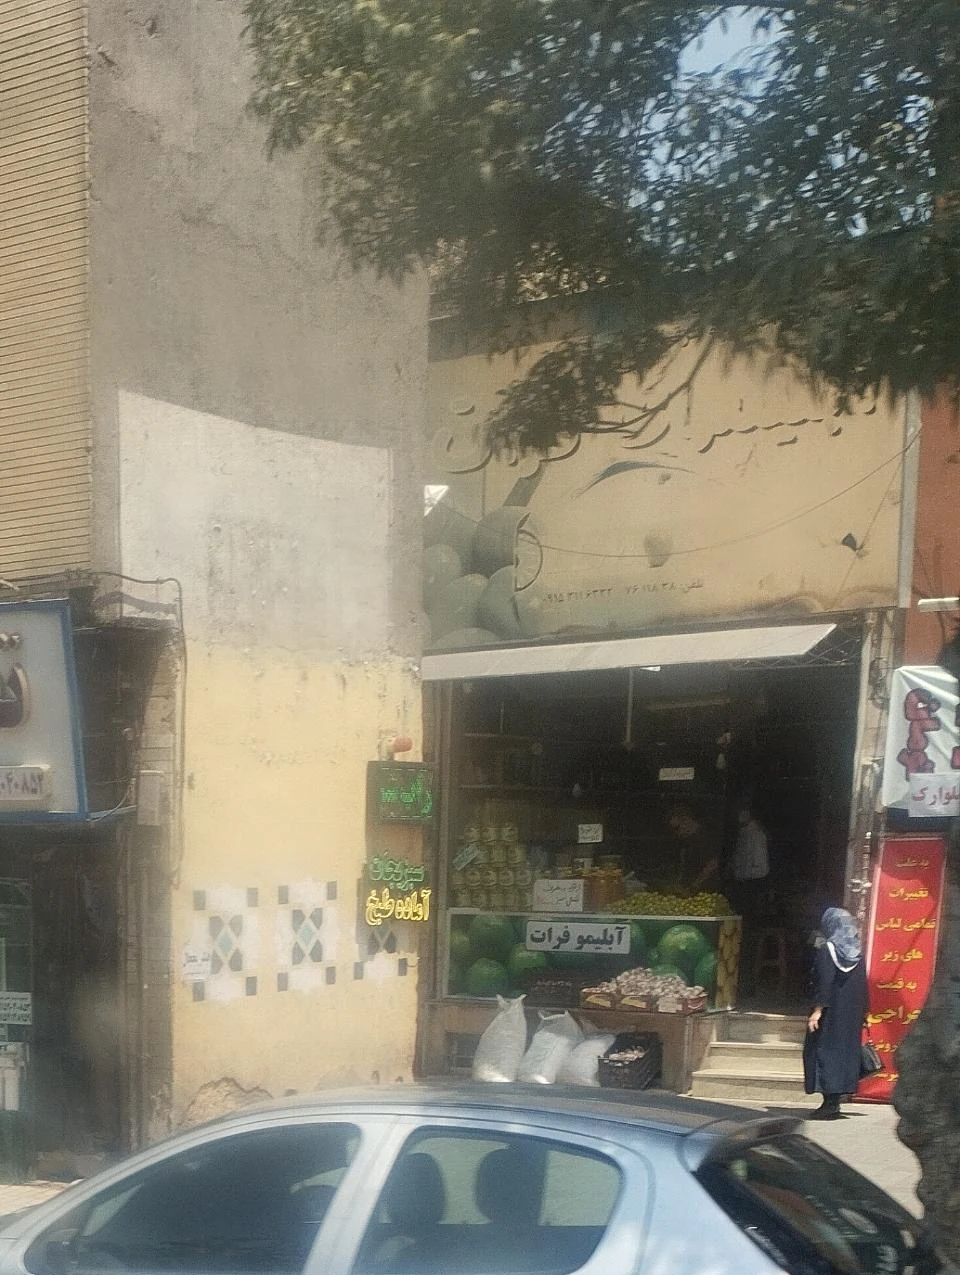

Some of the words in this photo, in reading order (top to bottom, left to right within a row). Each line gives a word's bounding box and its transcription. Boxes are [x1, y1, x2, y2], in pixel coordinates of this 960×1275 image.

[395, 888, 432, 921] آماده
[875, 916, 903, 932] لباس
[903, 917, 937, 932] تمامی
[530, 924, 571, 950] فرات
[574, 925, 627, 951] آبلیمو
[901, 948, 923, 962] های
[876, 977, 904, 992] قیمت
[905, 982, 918, 992] به
